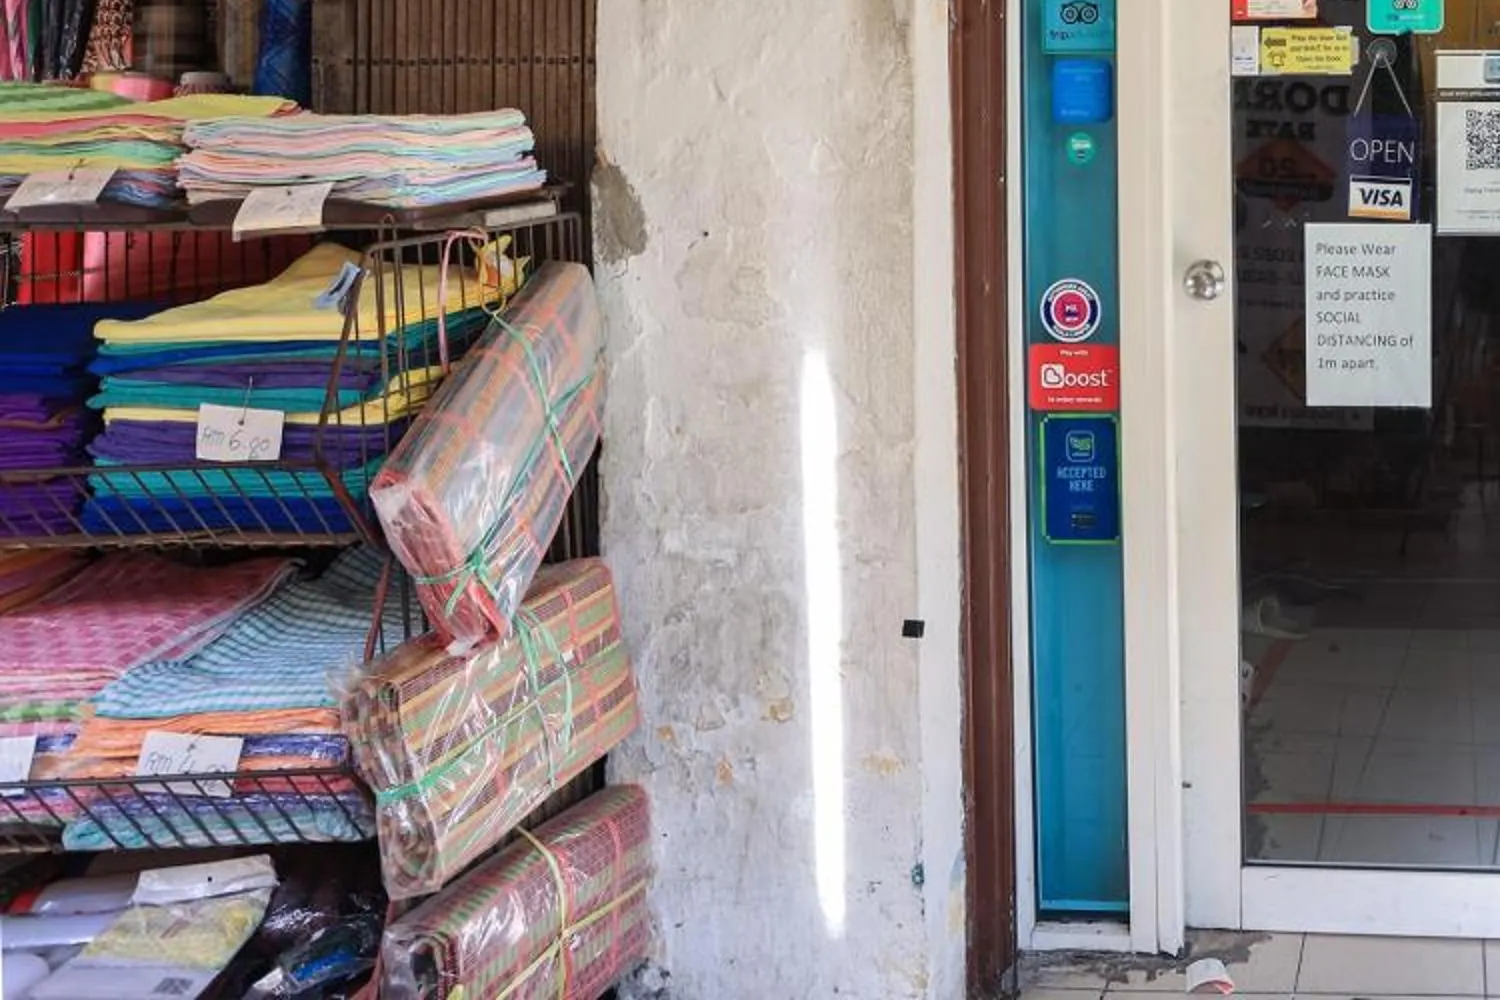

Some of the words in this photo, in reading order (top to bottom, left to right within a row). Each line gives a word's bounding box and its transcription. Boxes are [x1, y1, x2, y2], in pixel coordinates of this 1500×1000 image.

[1350, 137, 1415, 163] OPEN
[1360, 187, 1403, 207] VISA
[1316, 242, 1357, 256] Please
[1361, 242, 1397, 256] Wear
[1316, 265, 1349, 279] FACE
[1352, 265, 1391, 279] MASK
[1316, 288, 1341, 301] and
[1344, 288, 1397, 303] practice
[1316, 311, 1361, 324] SOCIAL
[1317, 334, 1397, 348] DISTANCING
[1400, 333, 1415, 347] of
[1041, 363, 1109, 389] Boost
[1056, 466, 1107, 479] ACCEPTED
[1069, 479, 1095, 492] HERE
